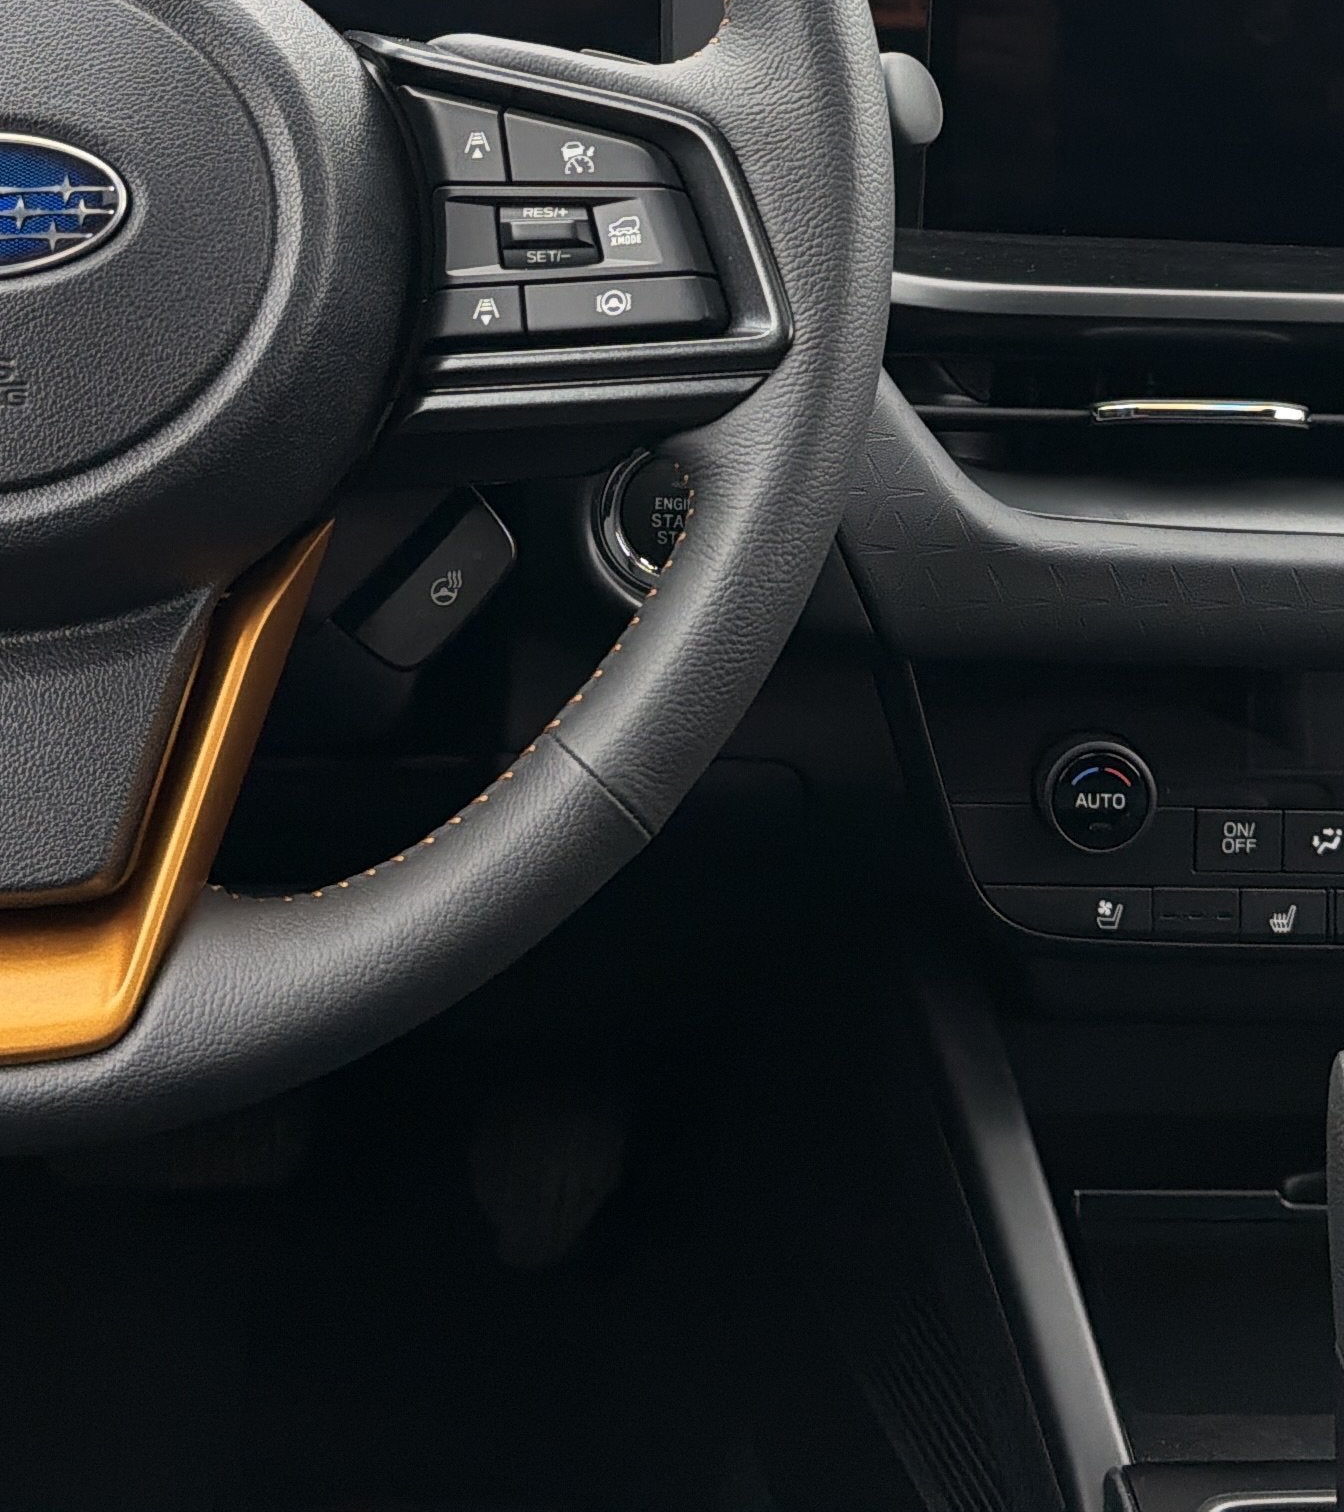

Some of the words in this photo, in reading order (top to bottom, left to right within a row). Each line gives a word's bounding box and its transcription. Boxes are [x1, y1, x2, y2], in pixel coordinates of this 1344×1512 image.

[655, 496, 690, 510] ENGI
[651, 512, 684, 528] STA
[657, 530, 678, 545] ST
[1074, 791, 1126, 811] AUTO
[1223, 821, 1256, 837] ON/
[1221, 837, 1257, 854] OFF
